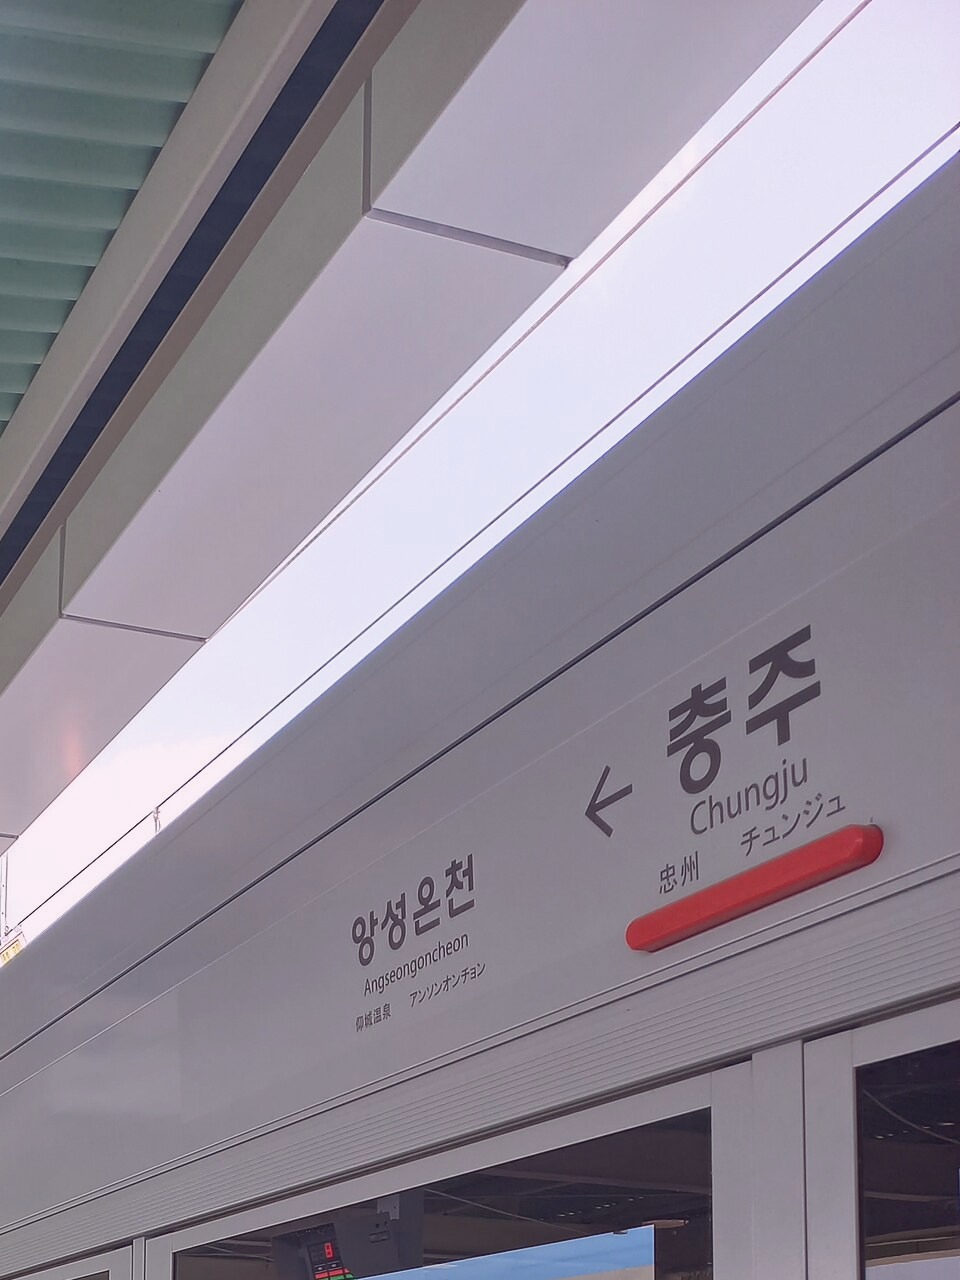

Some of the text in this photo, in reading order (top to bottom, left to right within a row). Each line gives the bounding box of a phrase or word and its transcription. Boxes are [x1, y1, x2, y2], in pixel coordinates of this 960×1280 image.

[666, 624, 822, 795] 충주
[690, 757, 808, 835] Chungju
[659, 792, 846, 894] 忠州 チュンジュ
[352, 853, 475, 966] 앙성온천
[364, 933, 469, 997] Angseongoncheon
[409, 963, 486, 1008] アンソンオンチョン
